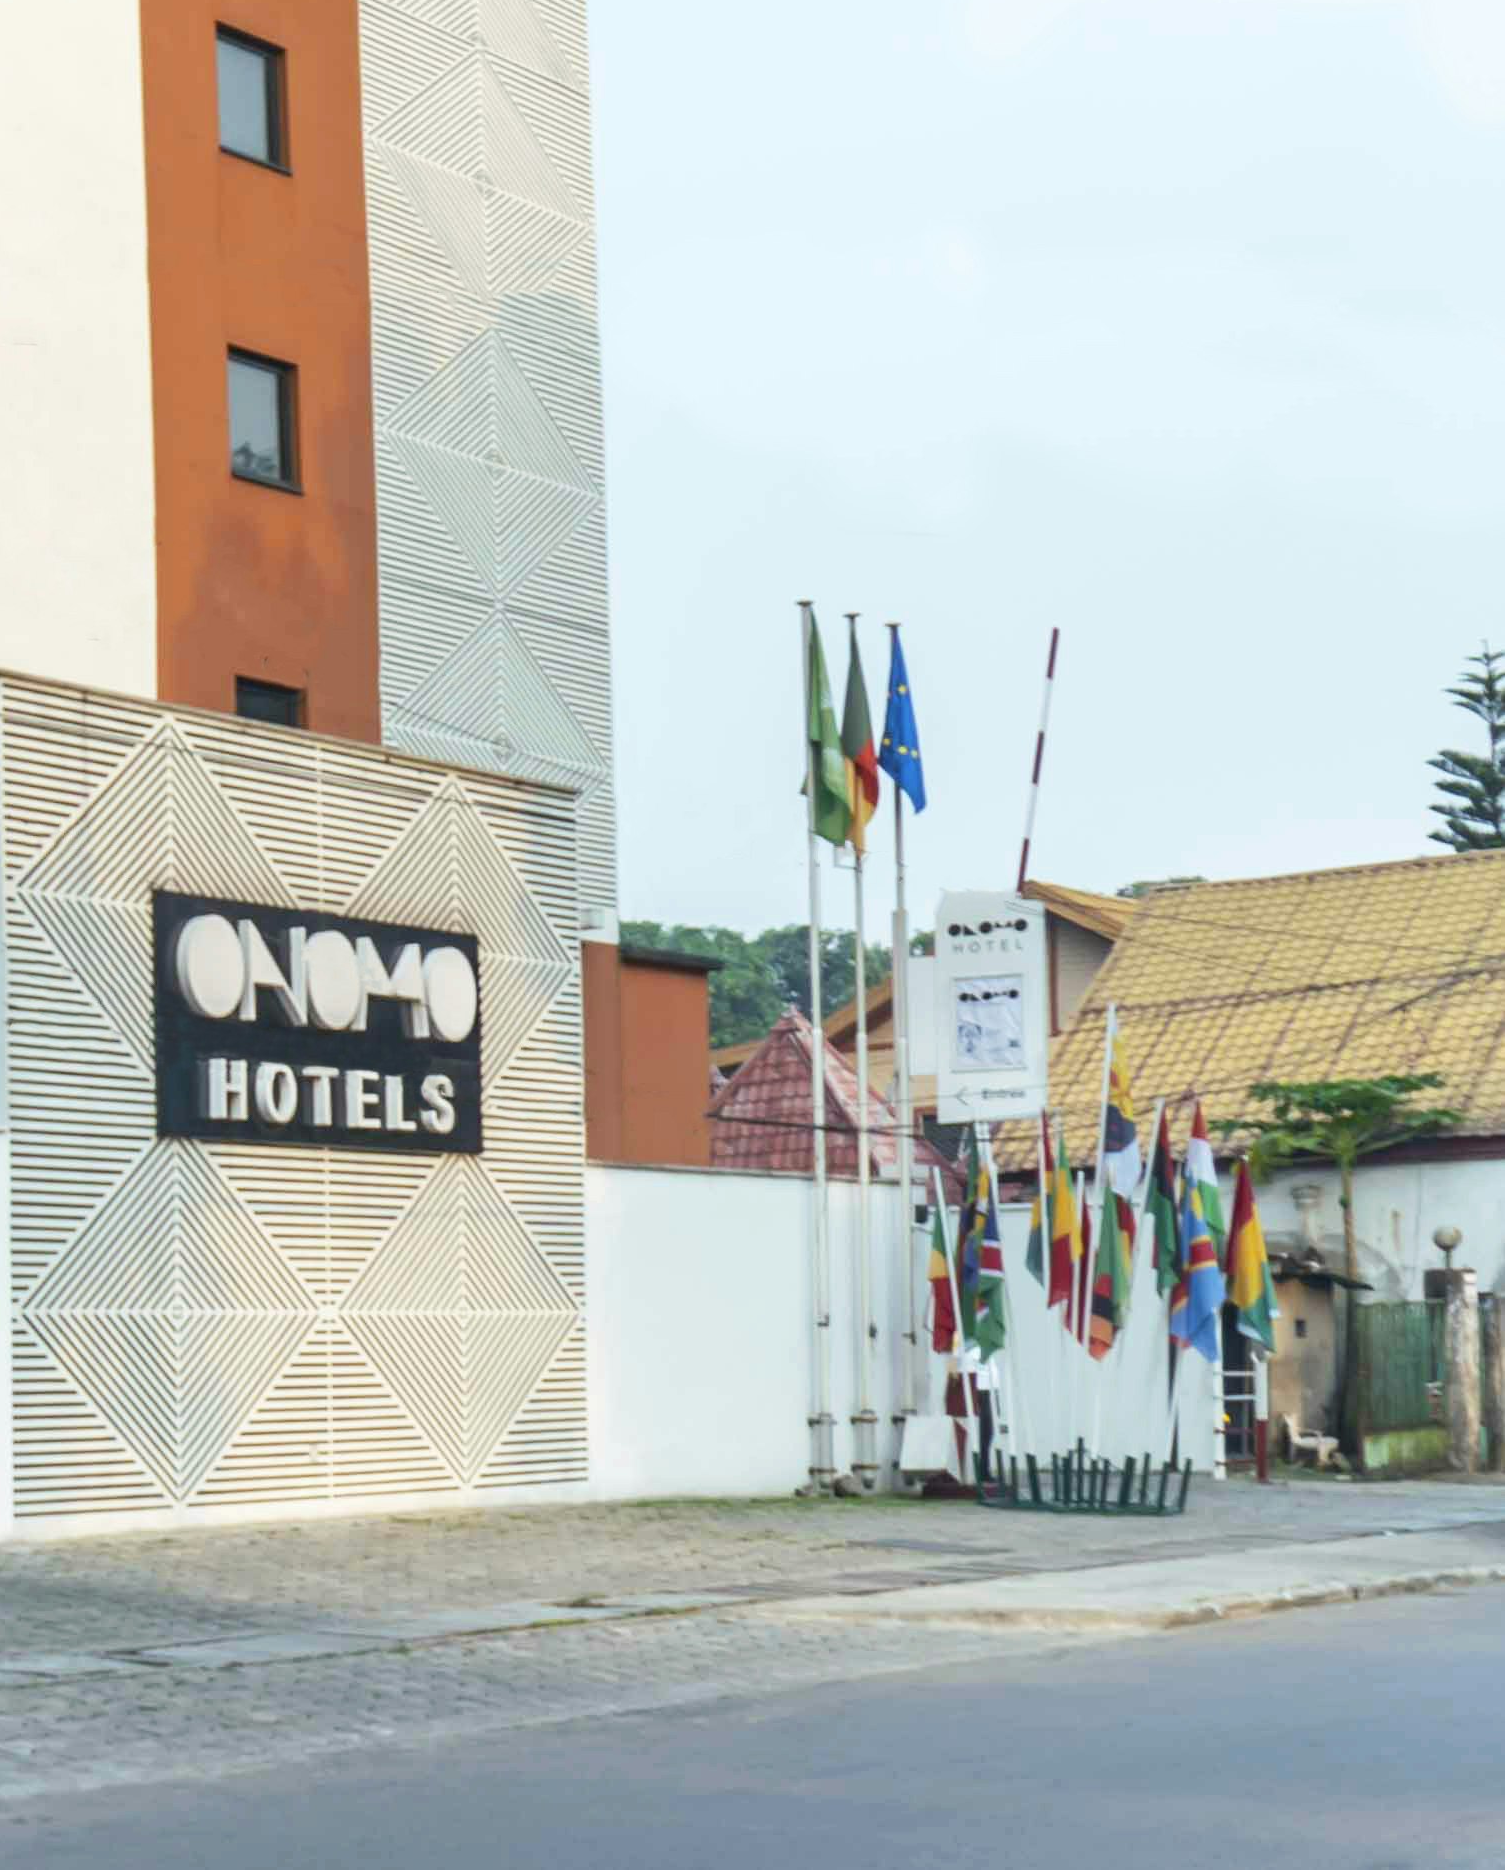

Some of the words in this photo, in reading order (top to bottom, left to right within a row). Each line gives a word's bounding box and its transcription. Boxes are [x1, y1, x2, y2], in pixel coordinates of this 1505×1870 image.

[177, 914, 477, 1042] ONOMO
[952, 939, 1023, 953] HOTEL
[206, 1058, 455, 1134] HOTELS
